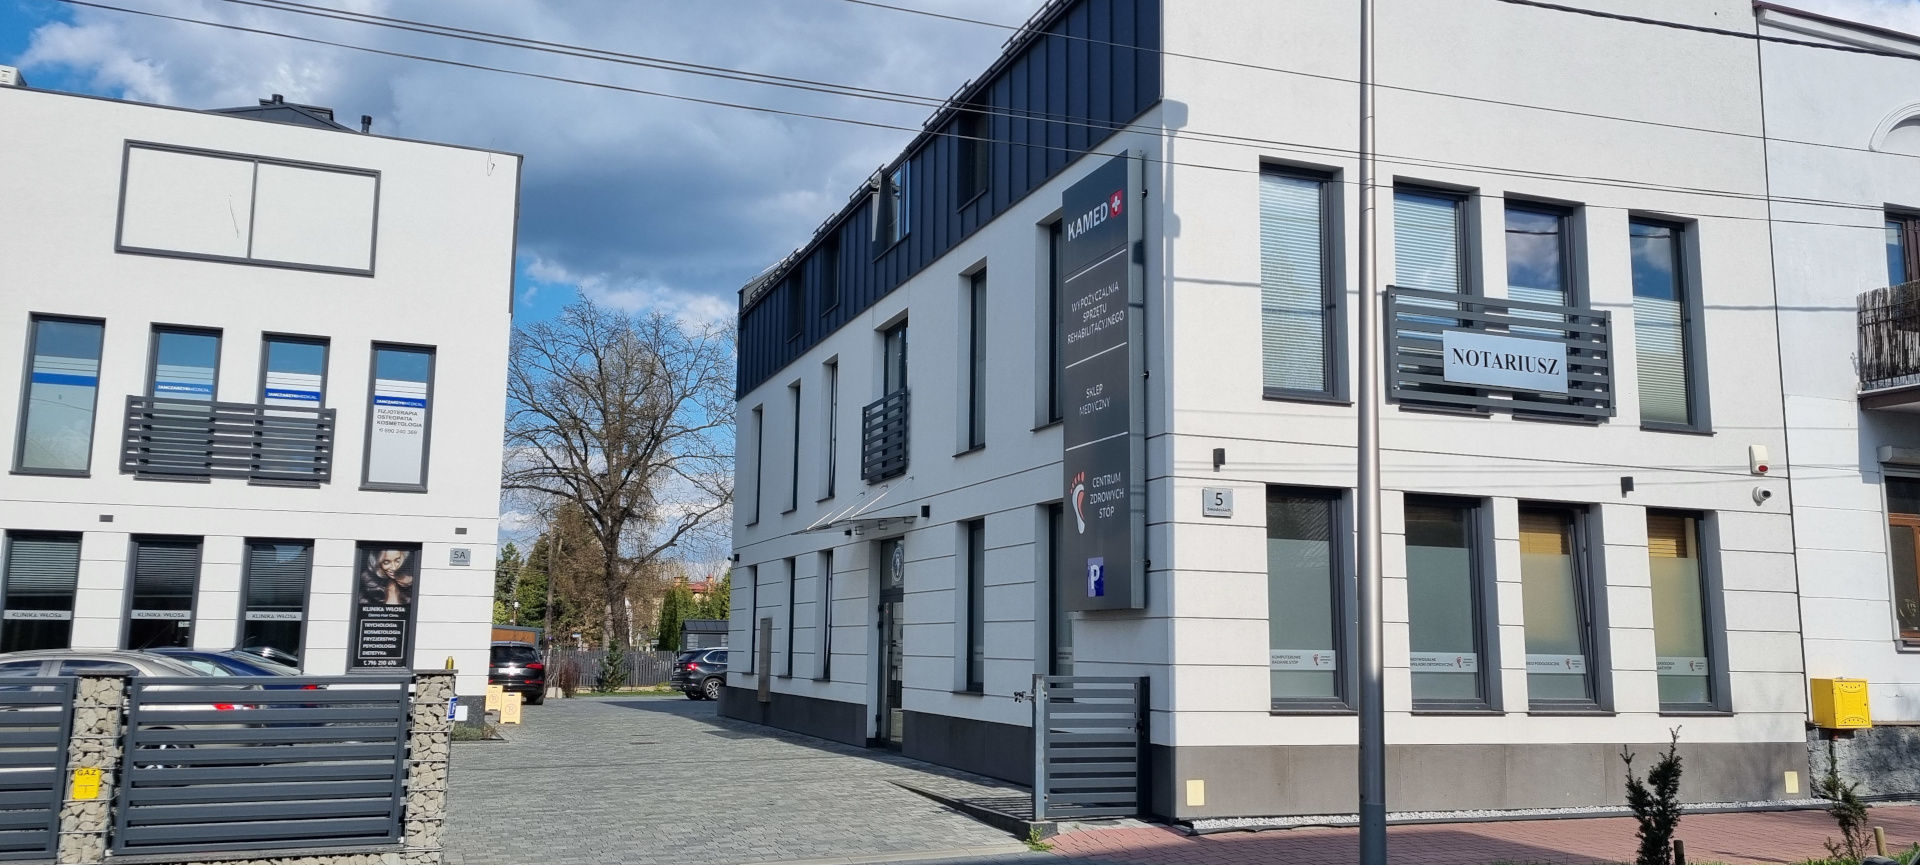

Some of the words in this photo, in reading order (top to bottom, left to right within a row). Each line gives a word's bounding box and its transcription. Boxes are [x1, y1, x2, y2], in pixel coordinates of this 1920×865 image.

[1068, 202, 1108, 242] KAMED
[1067, 310, 1125, 344] REHABILITACYJNEGO
[1452, 347, 1560, 376] NOTARIUSZ
[1086, 383, 1103, 399] SKLEP
[377, 408, 418, 416] FIZJOTERAPIA
[1079, 396, 1110, 416] MEDYCZNY
[376, 414, 413, 422] OSTEOPATIA
[376, 420, 423, 429] KOSMETOLOGIA
[1092, 472, 1121, 488] CENTRUM
[1089, 487, 1124, 505] ZDROWYCH
[1214, 492, 1223, 507] 5
[453, 550, 466, 560] 5A
[1090, 564, 1100, 590] P
